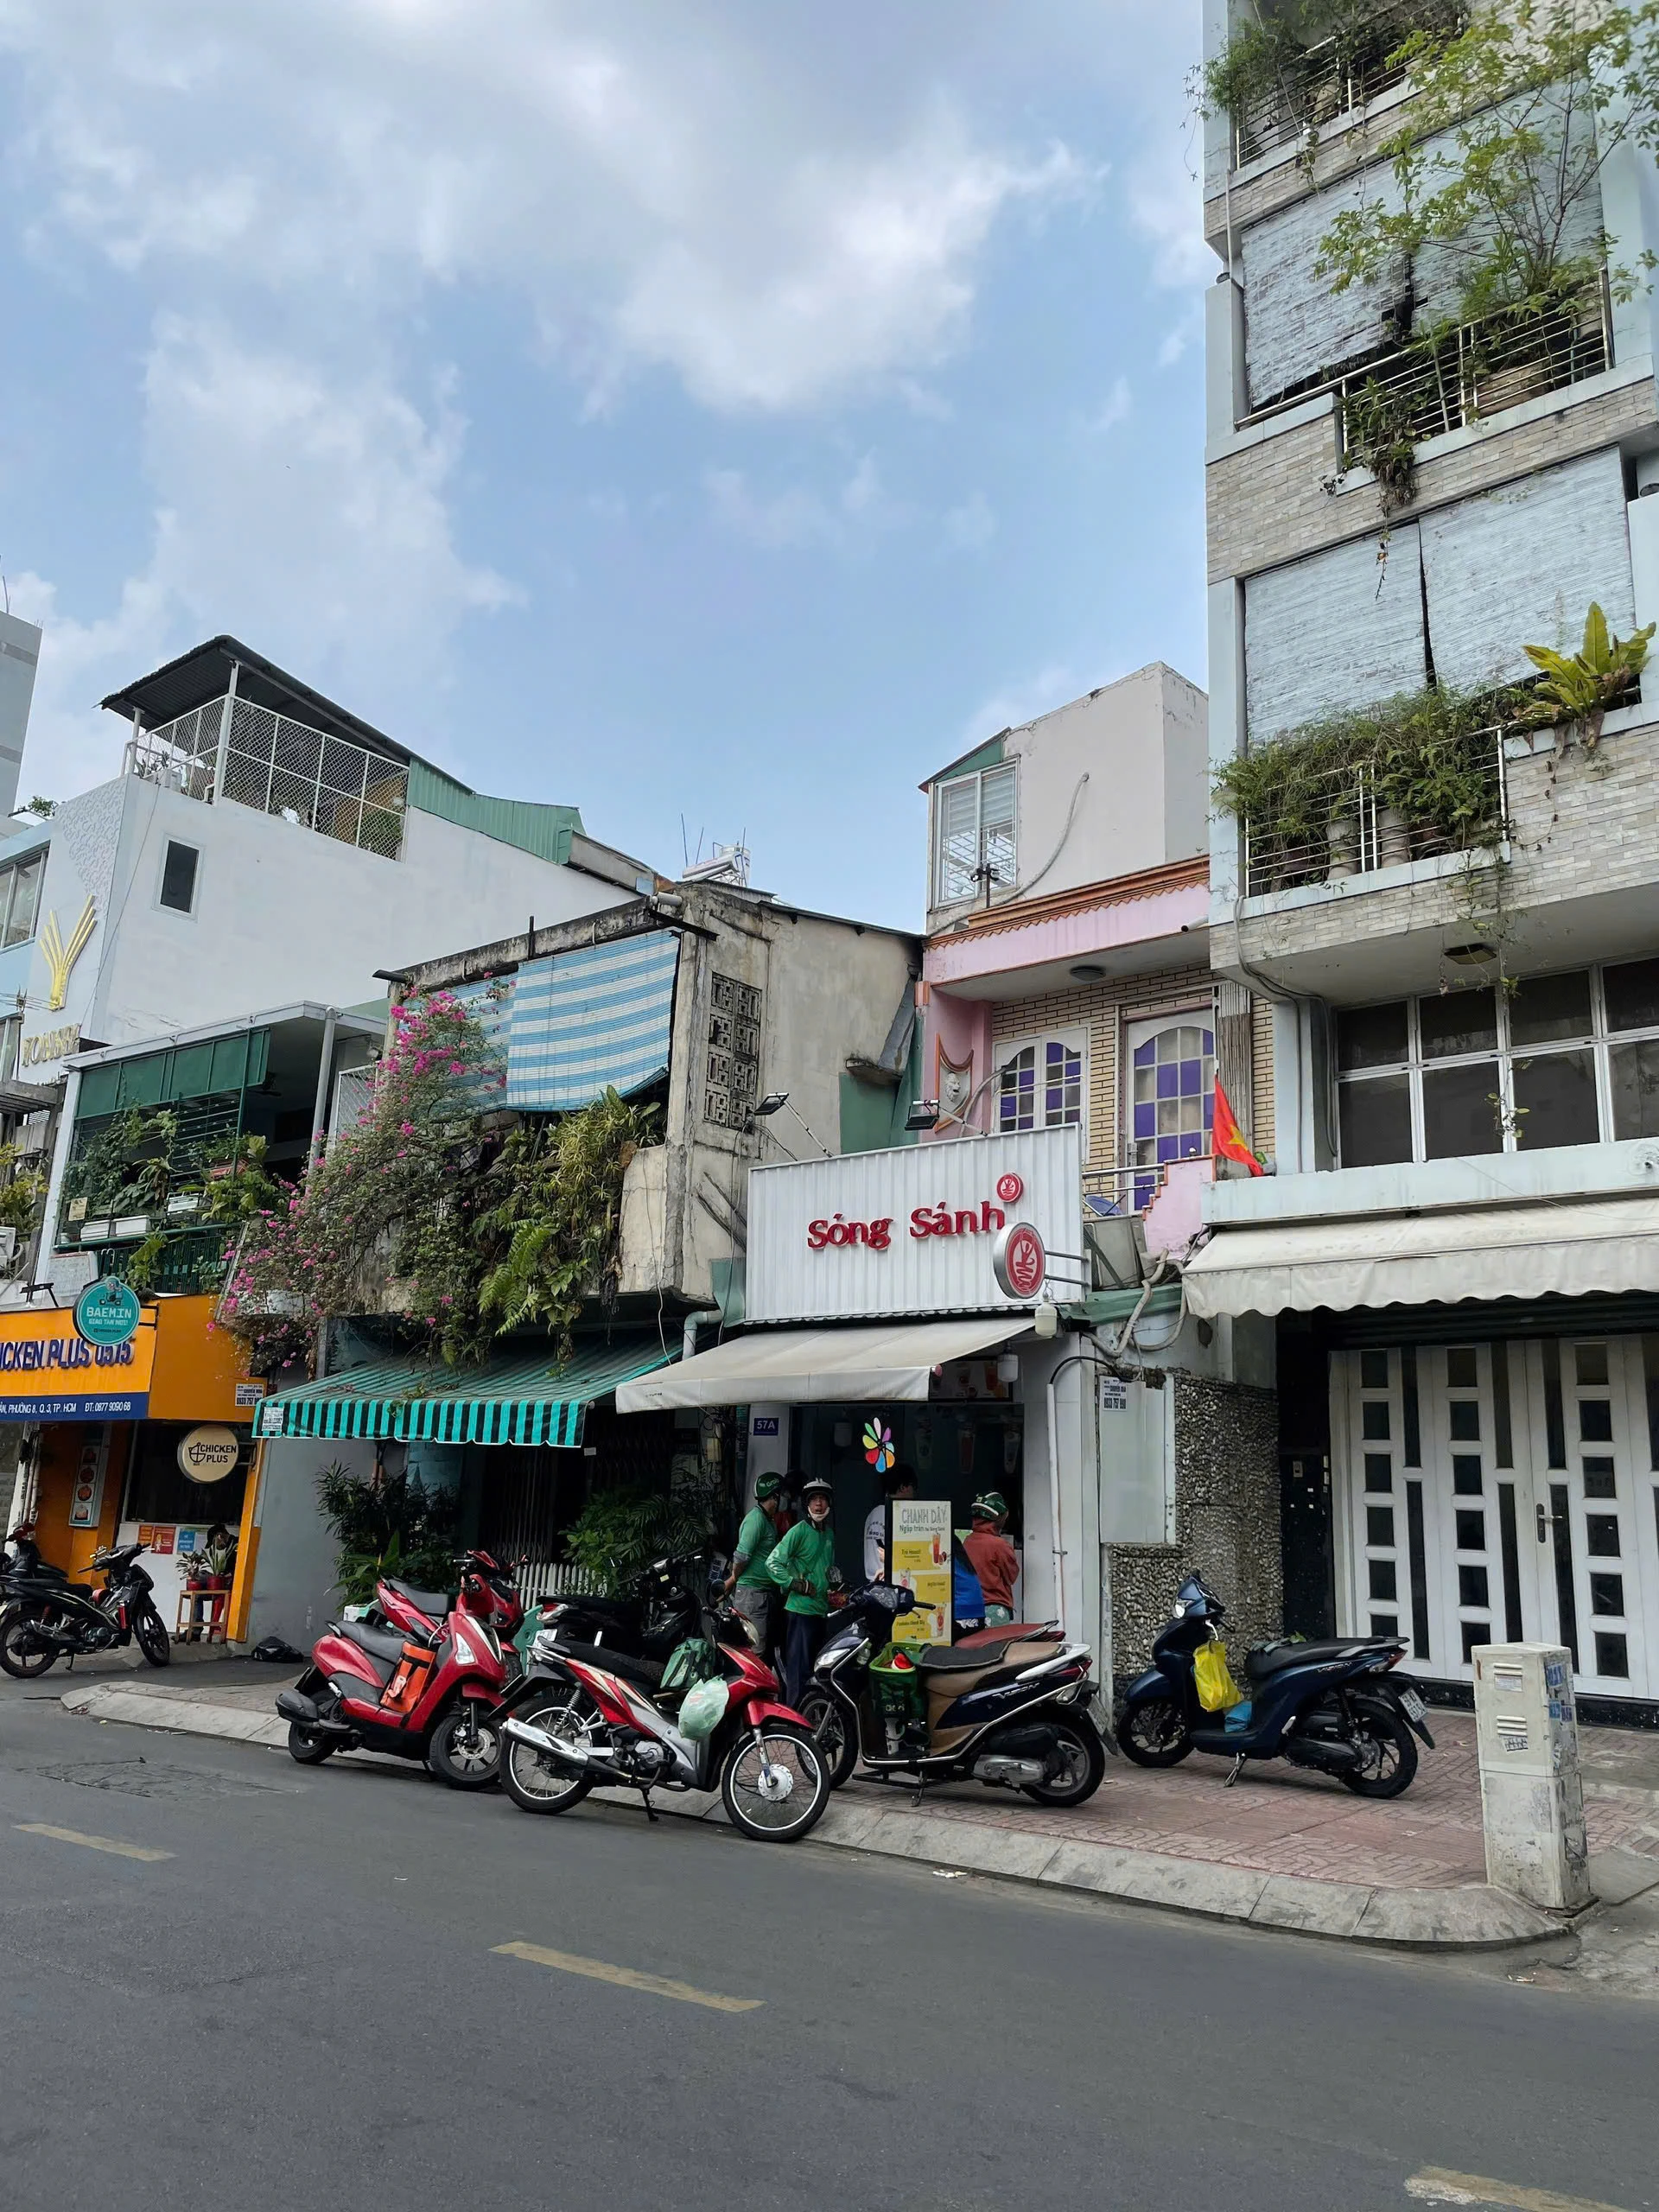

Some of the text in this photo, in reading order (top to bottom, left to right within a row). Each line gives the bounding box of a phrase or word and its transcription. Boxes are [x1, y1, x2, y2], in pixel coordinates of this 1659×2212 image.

[807, 1200, 1005, 1249] Sóng Sánh
[86, 1306, 132, 1319] BAEMIN
[0, 1340, 44, 1370] ICKEN
[47, 1338, 91, 1368] PLUS
[757, 1420, 776, 1430] 57A
[200, 1444, 238, 1453] CHICKEN
[206, 1454, 229, 1463] PLUS
[901, 1509, 929, 1524] CHANH
